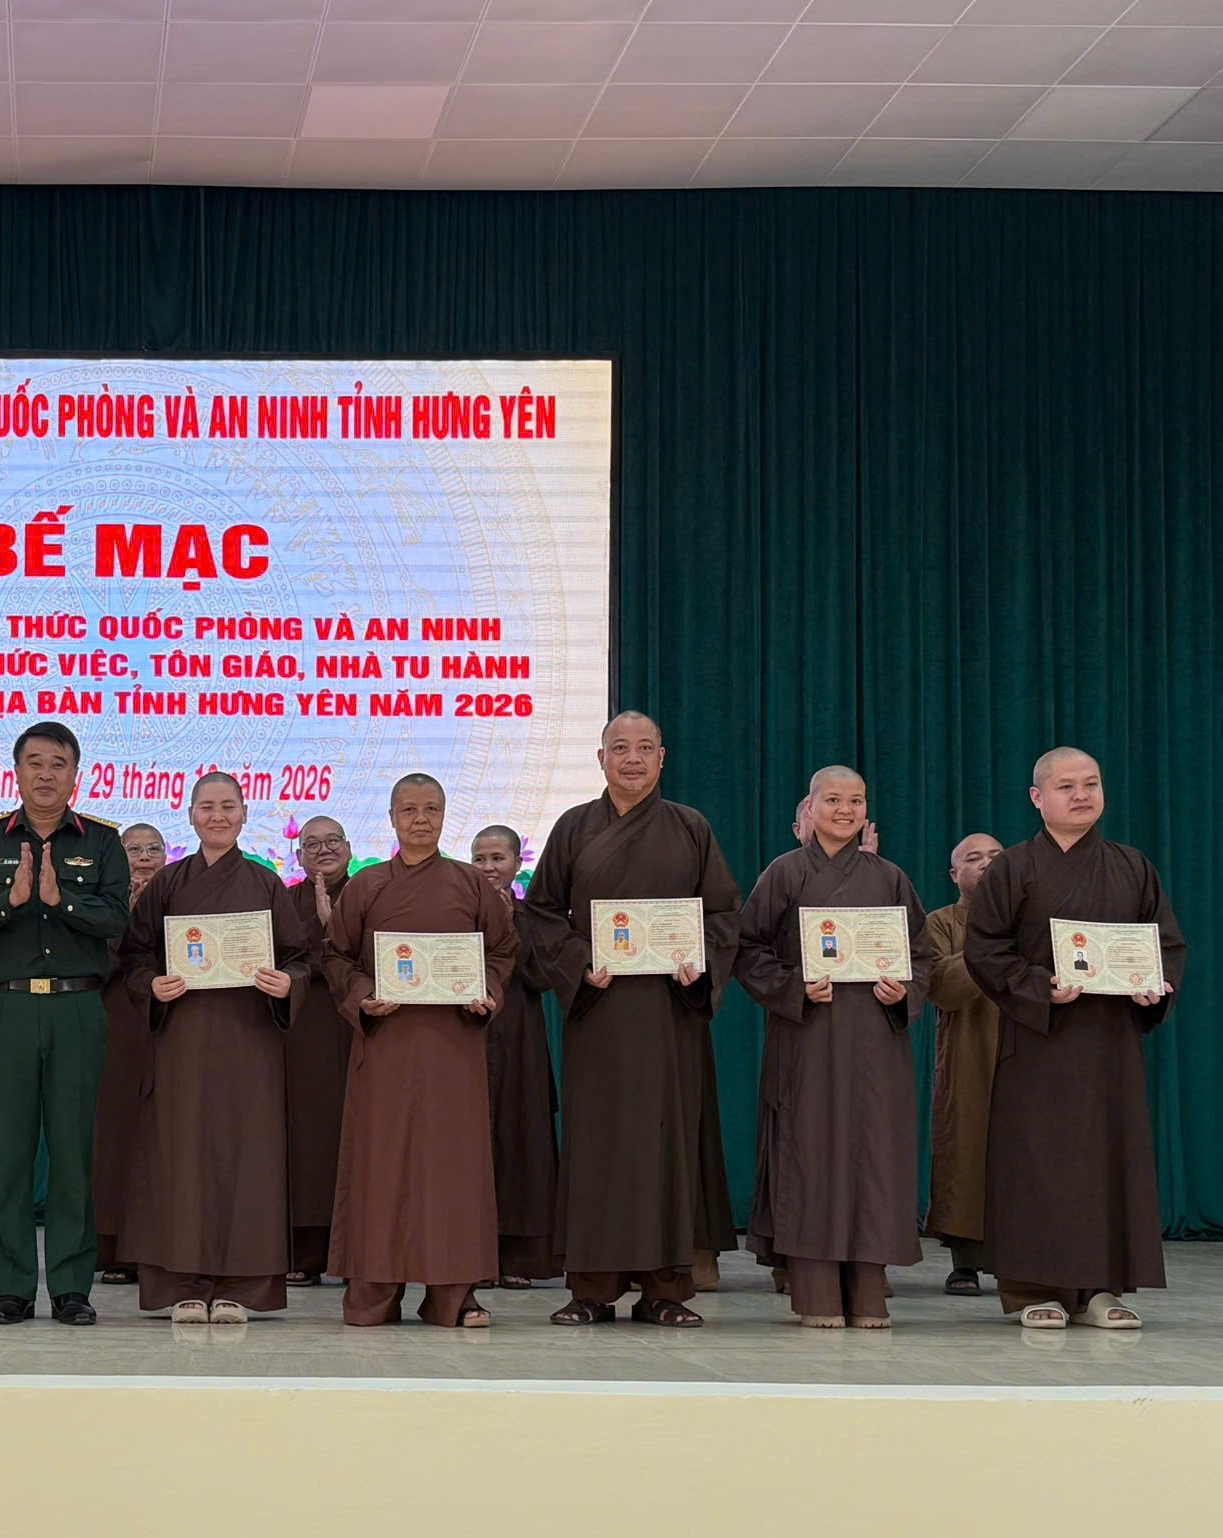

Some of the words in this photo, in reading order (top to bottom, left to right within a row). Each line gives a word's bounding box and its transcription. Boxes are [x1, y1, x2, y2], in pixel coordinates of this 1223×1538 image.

[58, 384, 155, 439] PHÒNG
[164, 386, 200, 439] VÀ
[209, 395, 249, 440] AN
[257, 395, 329, 440] NINH
[337, 381, 403, 440] TỈNH
[411, 390, 492, 441] HƯNG
[499, 386, 557, 440] YÊN
[94, 523, 271, 592] MẠC
[7, 608, 88, 640] THỨC
[99, 608, 184, 642] QUỐC
[195, 611, 303, 641] PHÒNG
[314, 612, 356, 641] VÀ
[364, 617, 410, 642] AN
[421, 617, 502, 642] NINH
[58, 649, 139, 681] VIỆC,
[150, 650, 212, 678] TÔN
[222, 653, 306, 682] GIÁO,
[316, 651, 383, 679] NHÀ
[391, 655, 431, 679] TU
[441, 651, 531, 680] HÀNH
[37, 685, 103, 715] BÀN
[114, 684, 187, 716] TỈNH
[198, 689, 285, 717] HƯNG
[296, 689, 358, 717] YÊN
[369, 689, 444, 718] NĂM
[454, 693, 534, 718] 2026
[89, 762, 116, 800] 29
[122, 762, 186, 810] tháng
[229, 761, 272, 801] ăm
[278, 764, 333, 802] 2026
